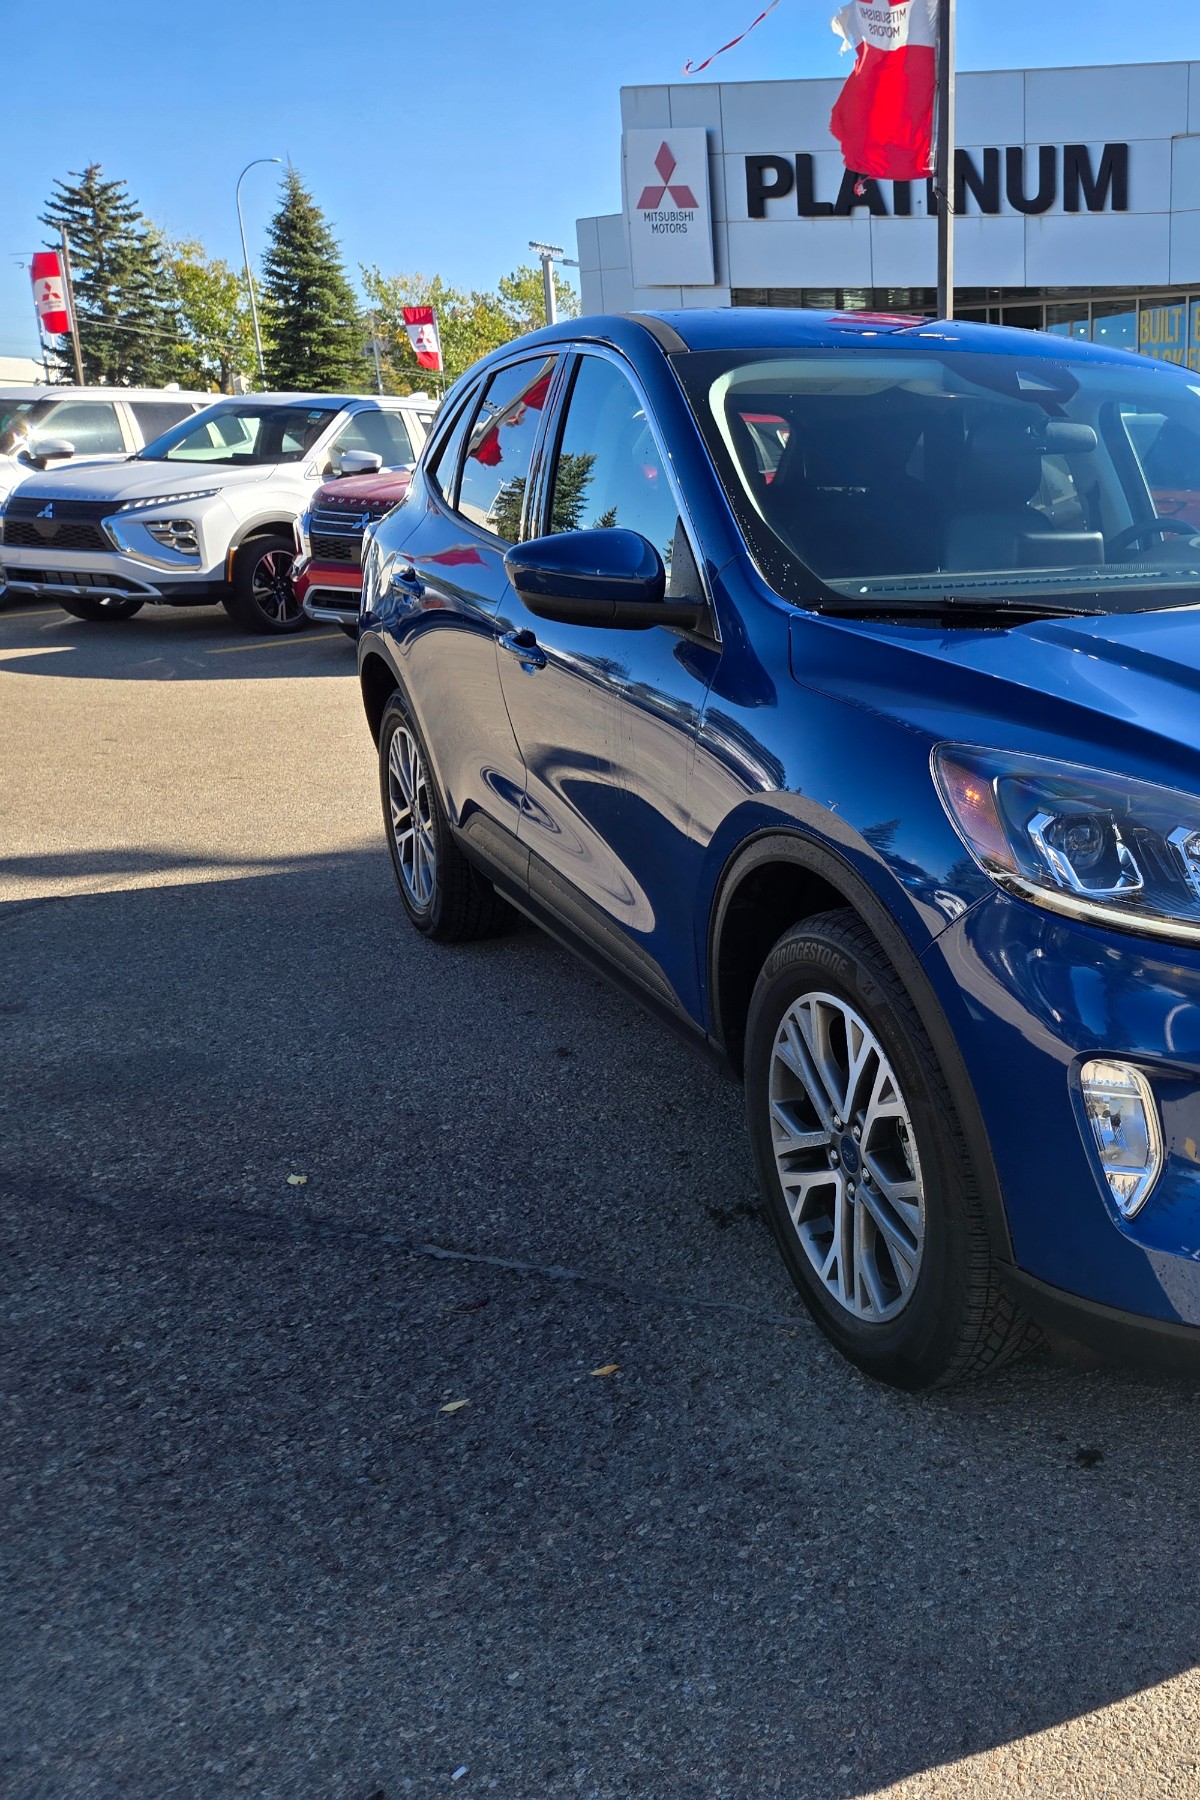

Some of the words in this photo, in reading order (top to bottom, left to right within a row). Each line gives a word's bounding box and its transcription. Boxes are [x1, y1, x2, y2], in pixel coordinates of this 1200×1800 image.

[643, 211, 694, 222] MITSUBISHI
[651, 223, 688, 234] MOTORS
[1139, 307, 1184, 344] BUILT
[327, 496, 395, 507] OUTLAN
[772, 941, 849, 977] BRIDGESTONE
